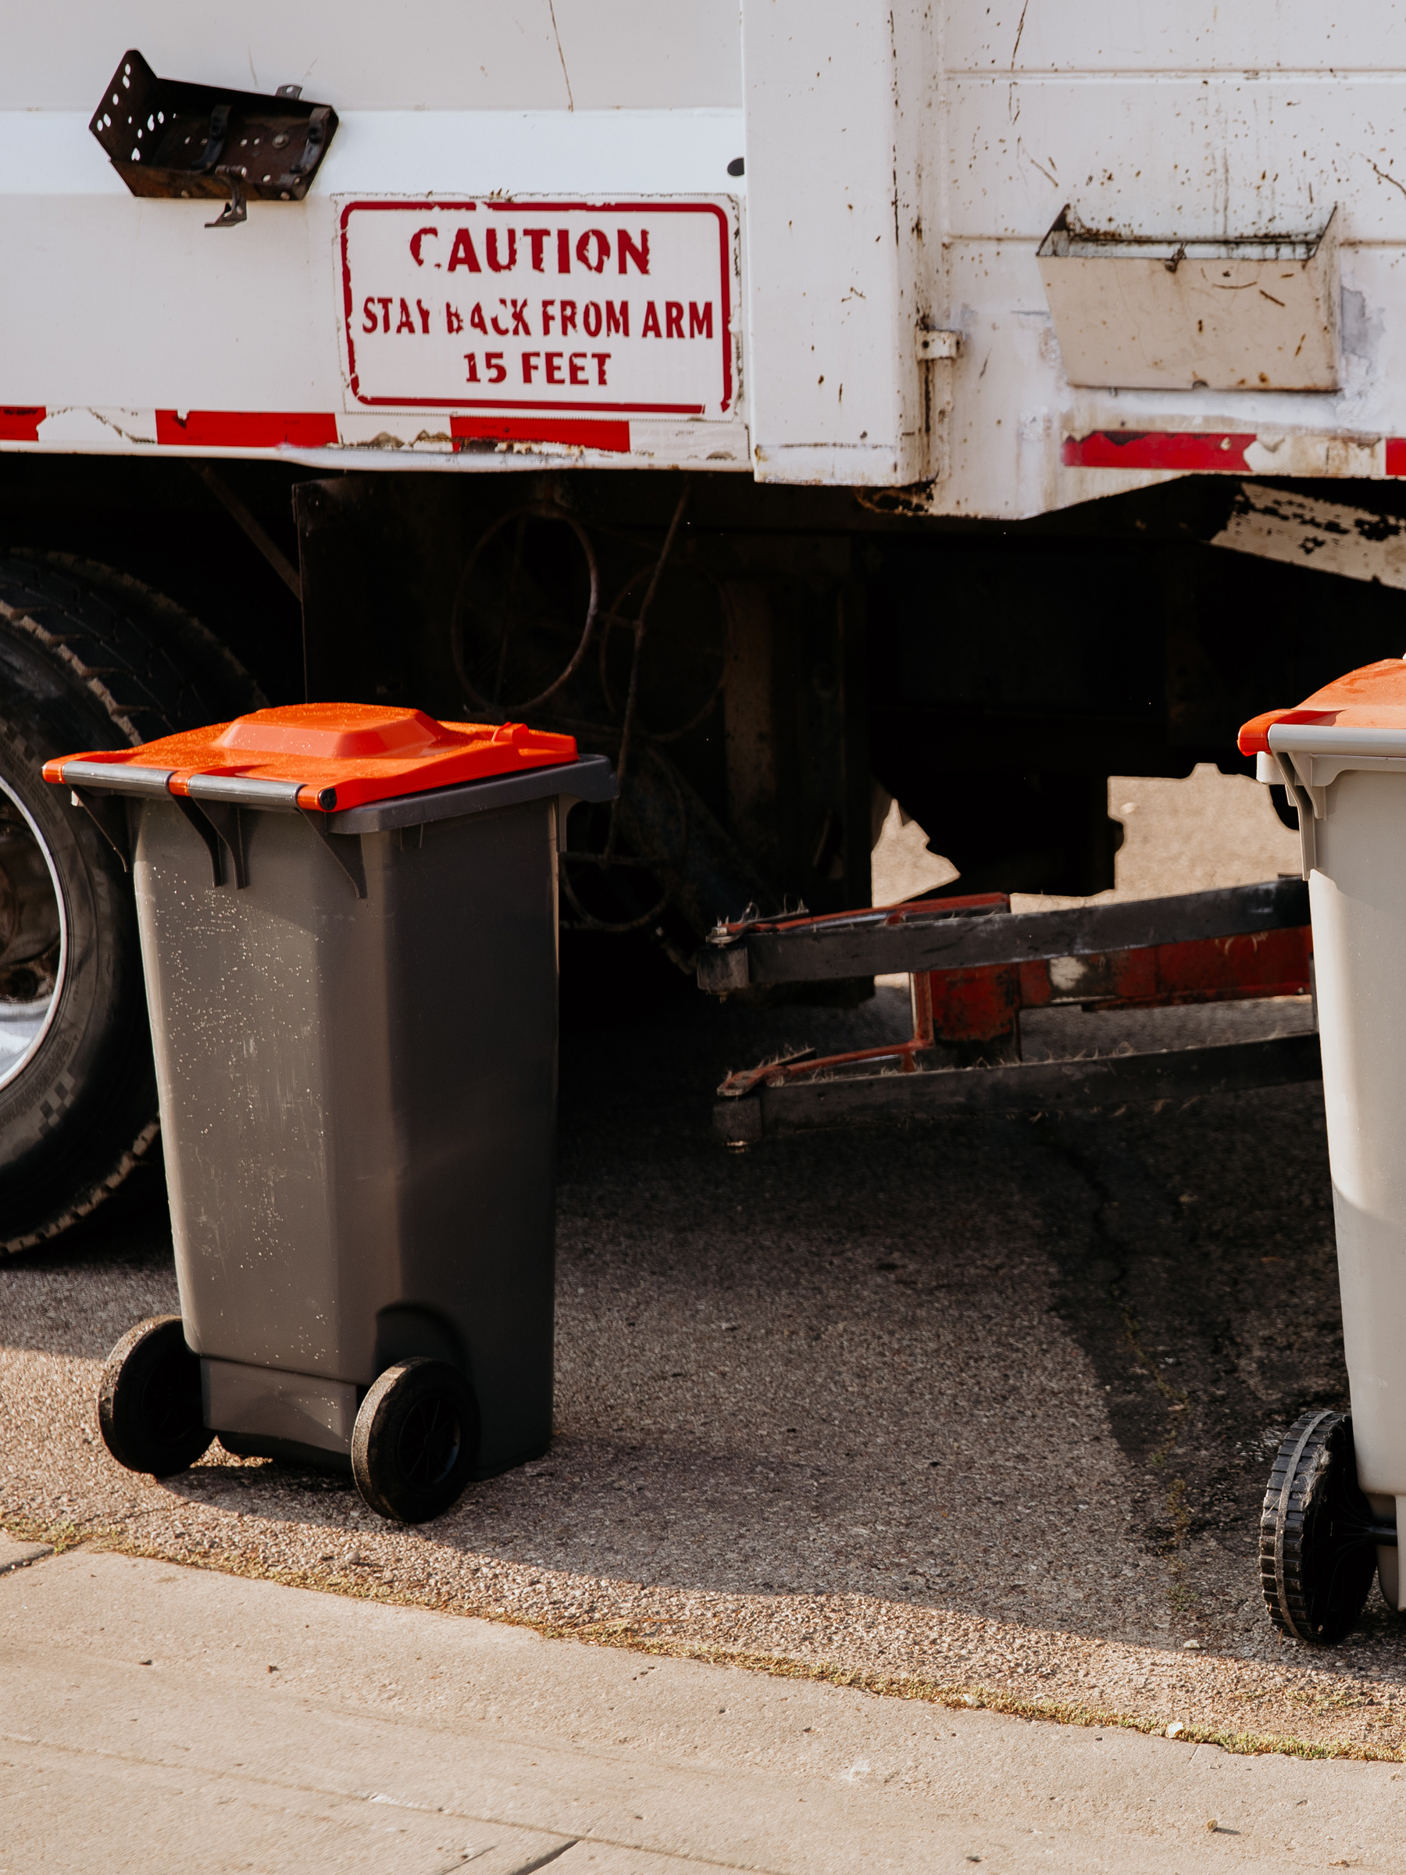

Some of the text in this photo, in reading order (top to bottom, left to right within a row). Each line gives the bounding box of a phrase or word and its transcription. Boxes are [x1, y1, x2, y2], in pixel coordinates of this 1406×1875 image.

[410, 226, 652, 275] CAUTION
[362, 296, 431, 335] STAY
[542, 298, 630, 338] FROM
[641, 300, 713, 340] ARM
[463, 351, 612, 386] 15 FEET
